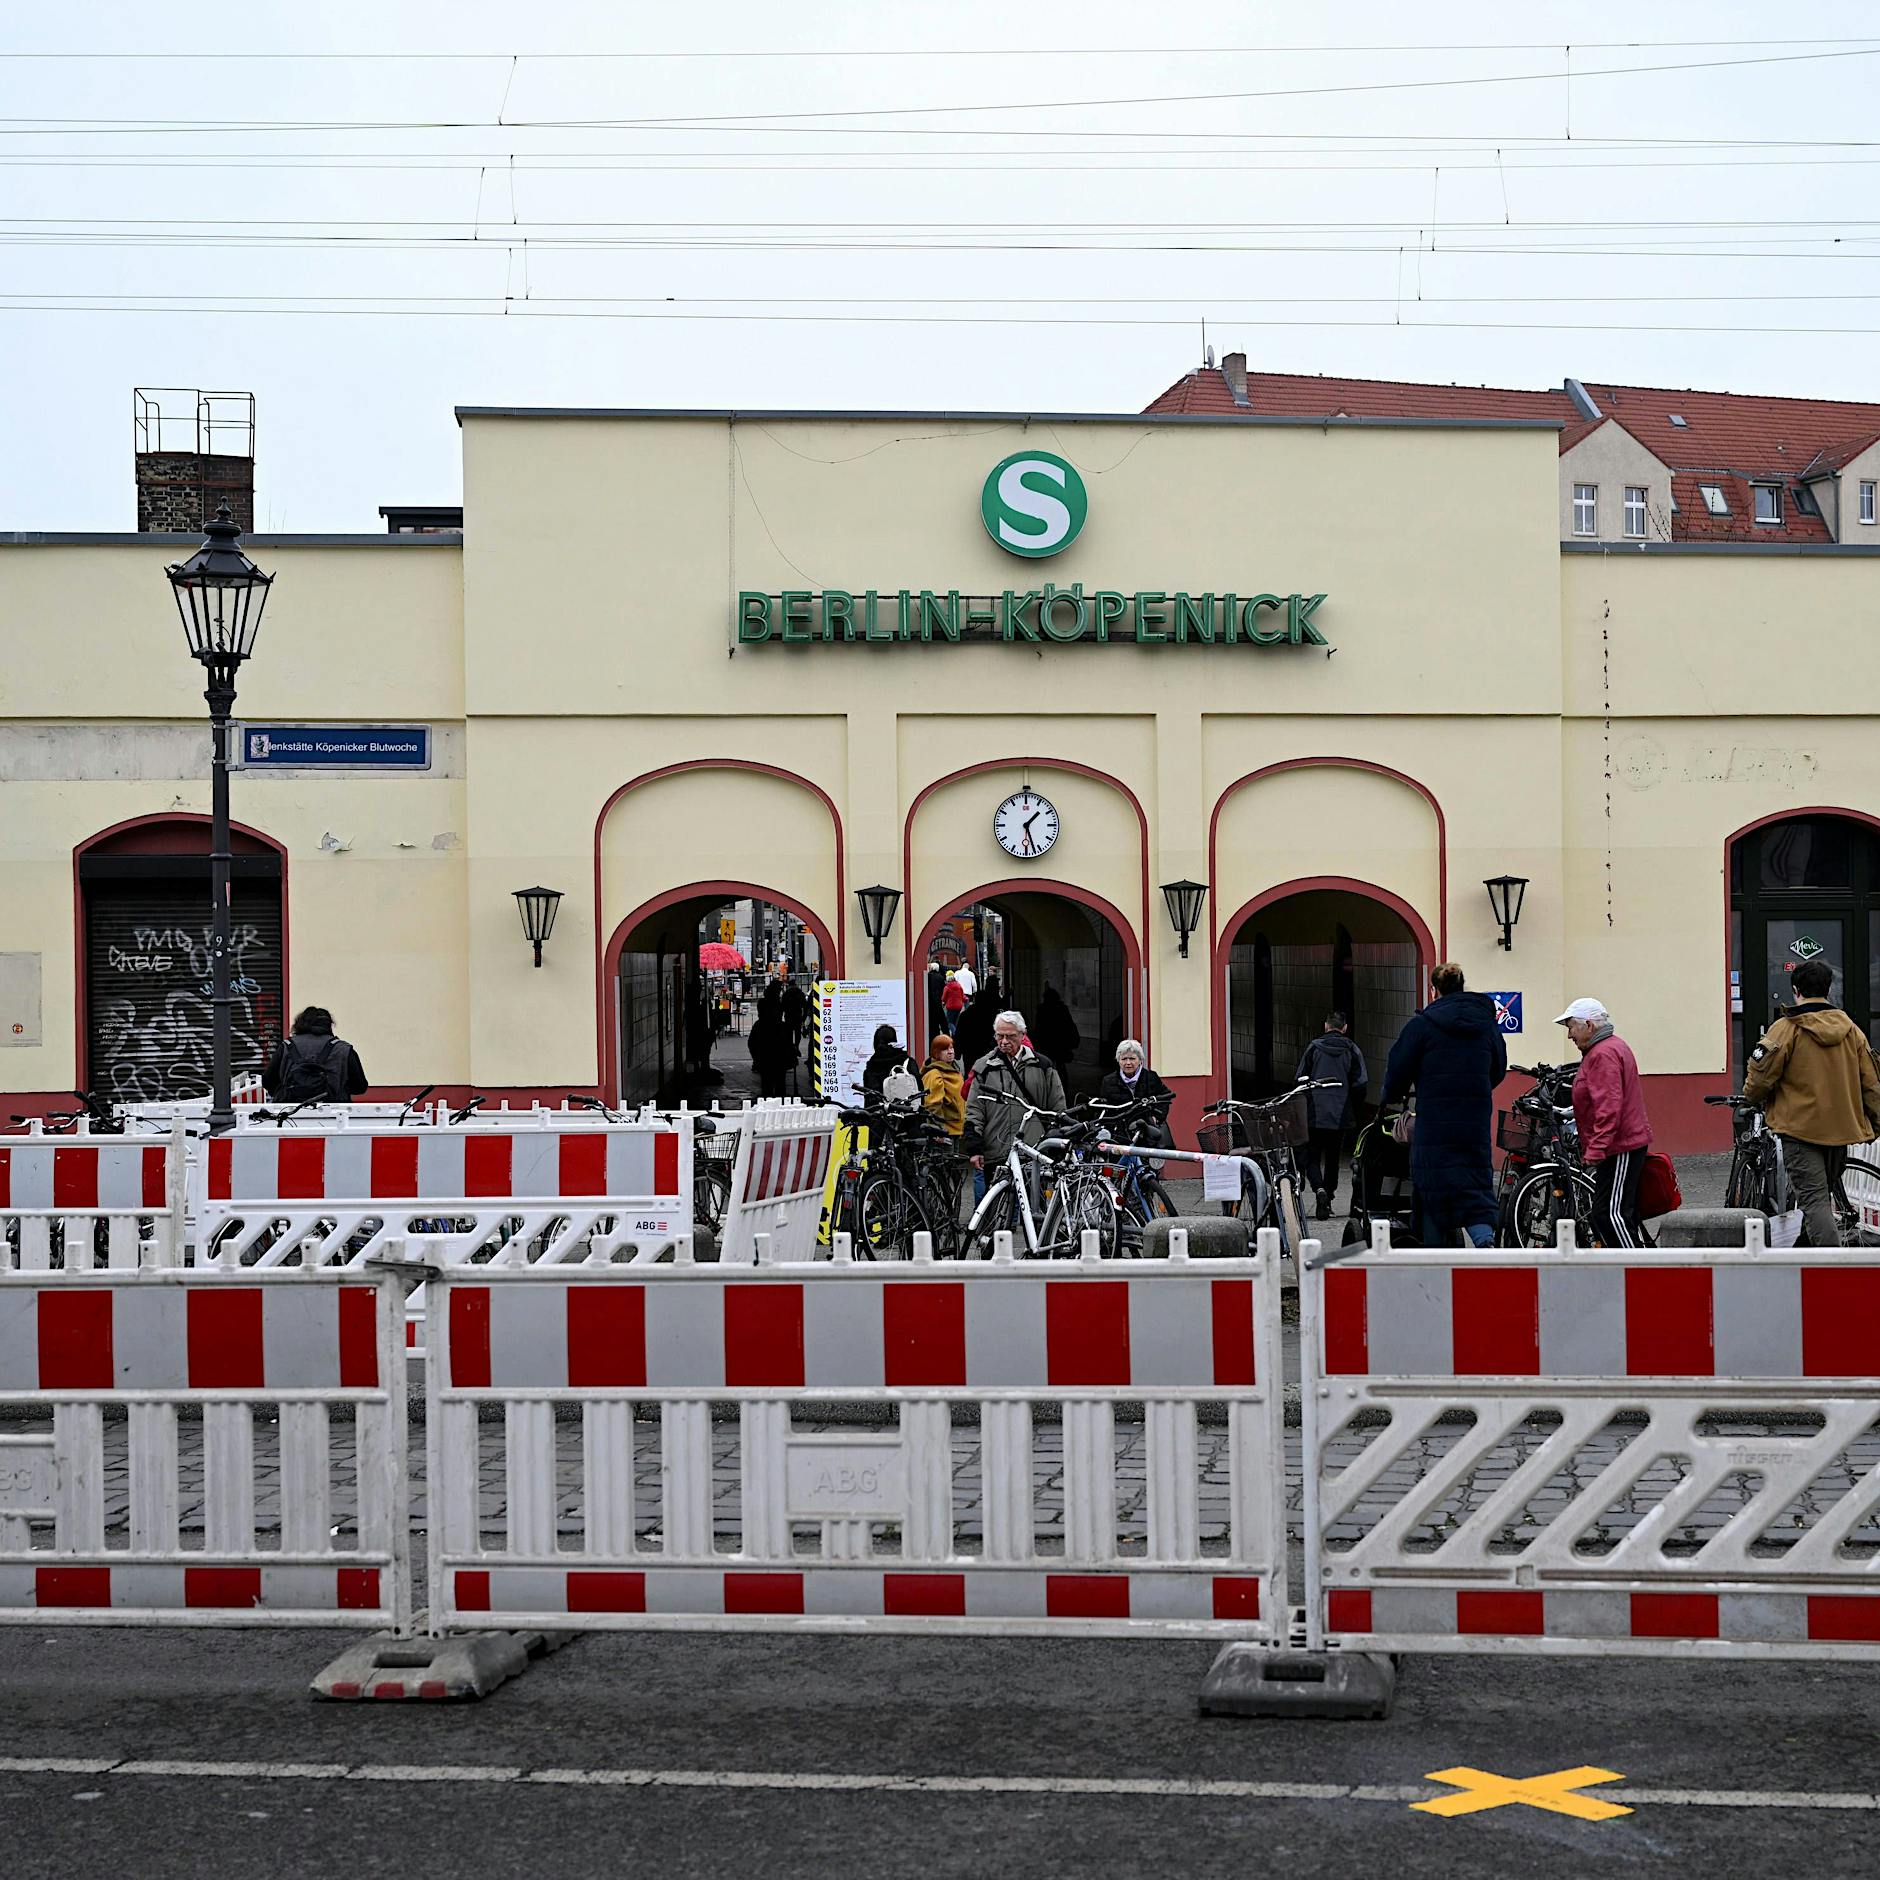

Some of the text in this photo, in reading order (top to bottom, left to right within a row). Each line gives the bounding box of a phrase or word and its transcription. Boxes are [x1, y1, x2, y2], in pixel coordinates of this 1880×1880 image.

[998, 459, 1071, 550] S
[738, 582, 1329, 646] BERLIN-KÖPENICK
[316, 742, 367, 754] Köpenicker
[370, 742, 418, 752] Blutwoche
[635, 1221, 656, 1230] ABG
